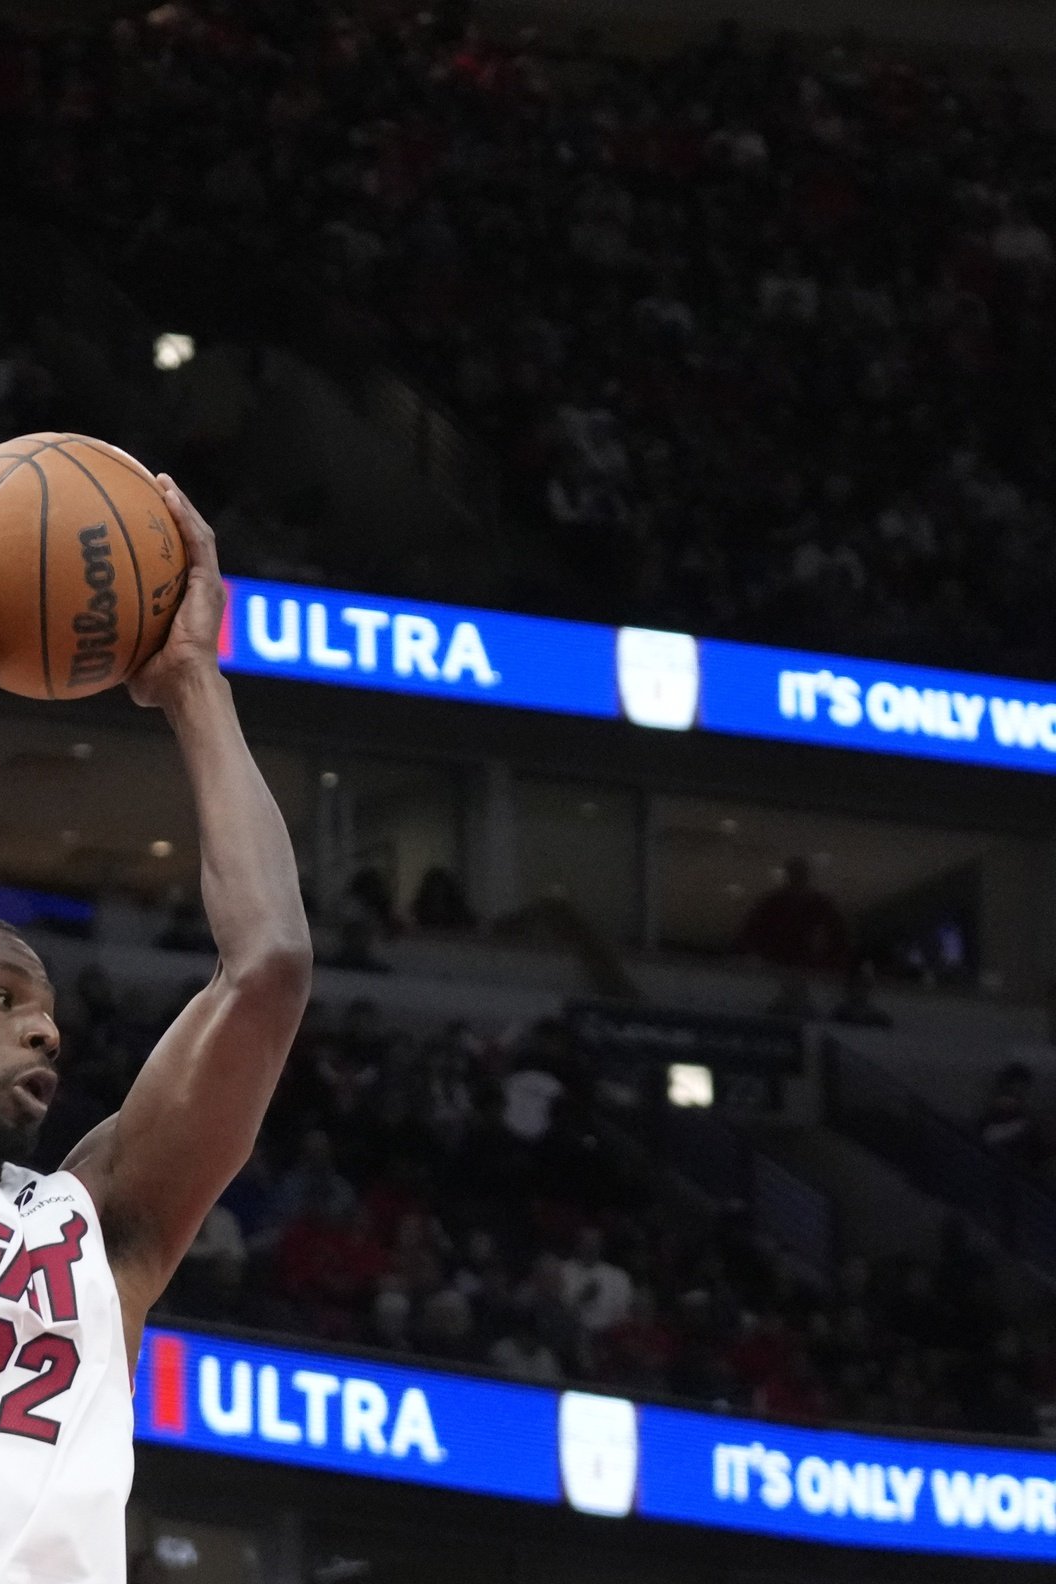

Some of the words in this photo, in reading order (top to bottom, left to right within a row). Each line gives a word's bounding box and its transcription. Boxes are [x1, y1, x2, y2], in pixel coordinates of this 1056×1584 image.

[66, 521, 119, 688] Wilson
[247, 595, 496, 686] ULTRA
[778, 669, 863, 727] IT'S
[865, 681, 986, 740] ONLY
[199, 1355, 446, 1464] ULTRA
[713, 1442, 793, 1509] IT'S
[795, 1455, 925, 1521] ONLY
